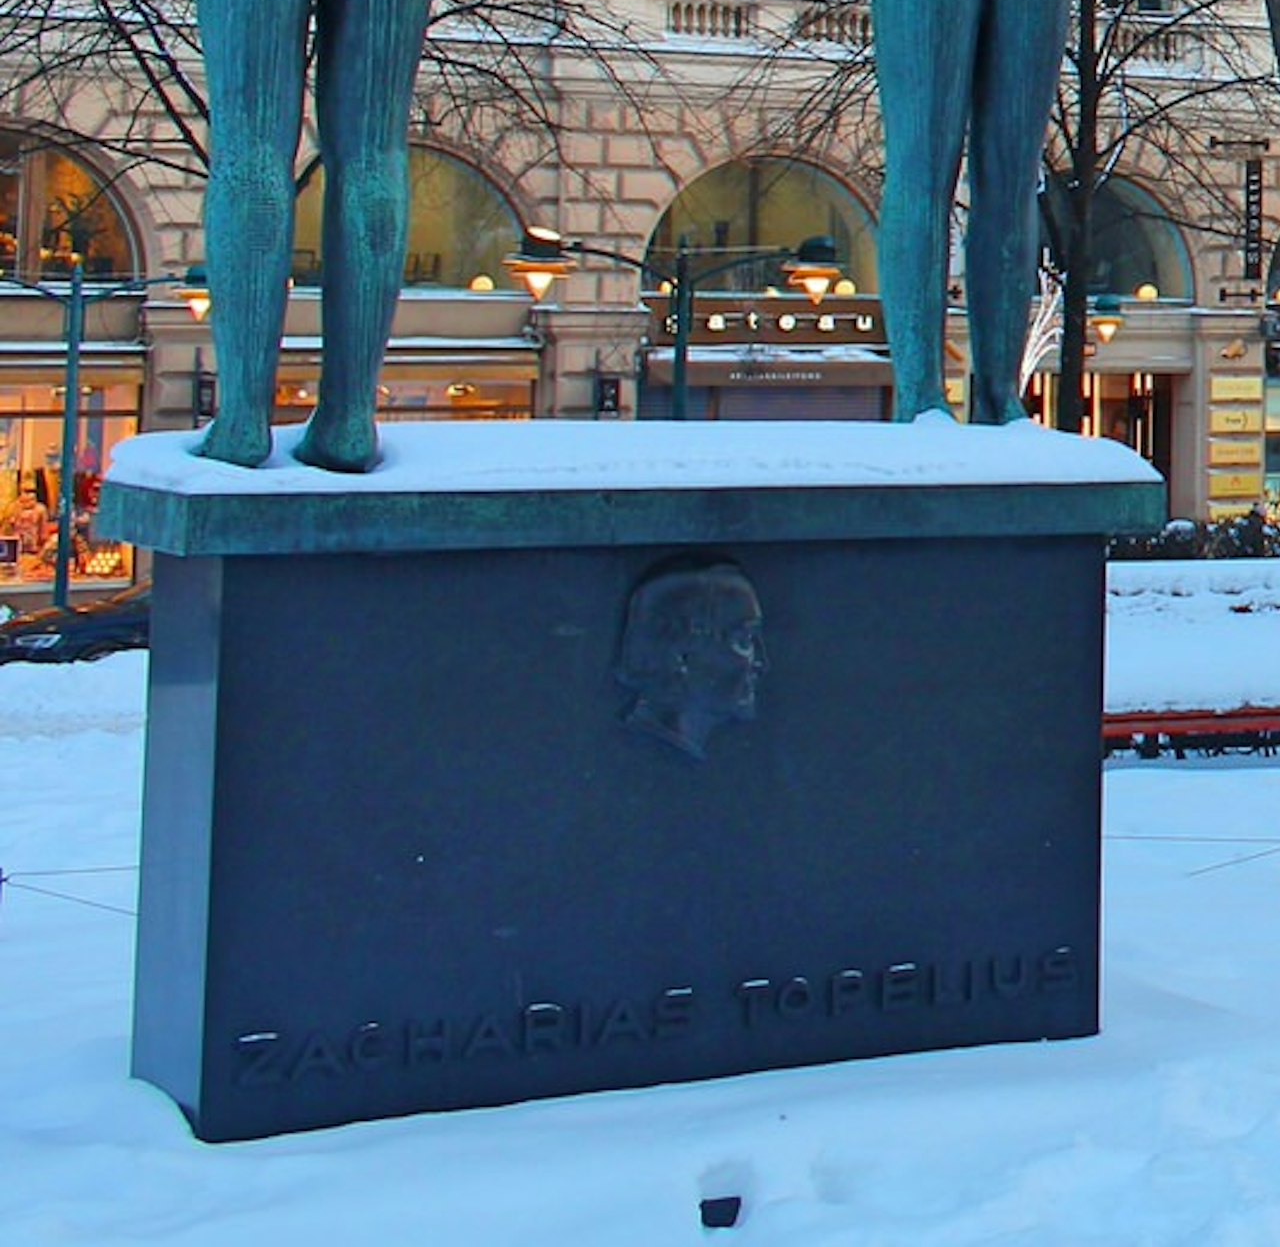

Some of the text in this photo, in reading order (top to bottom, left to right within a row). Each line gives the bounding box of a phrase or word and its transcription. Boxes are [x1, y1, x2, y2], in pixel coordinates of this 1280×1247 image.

[666, 313, 873, 334] gateau
[232, 946, 1080, 1086] ZACHARIAS TOPELIUS
